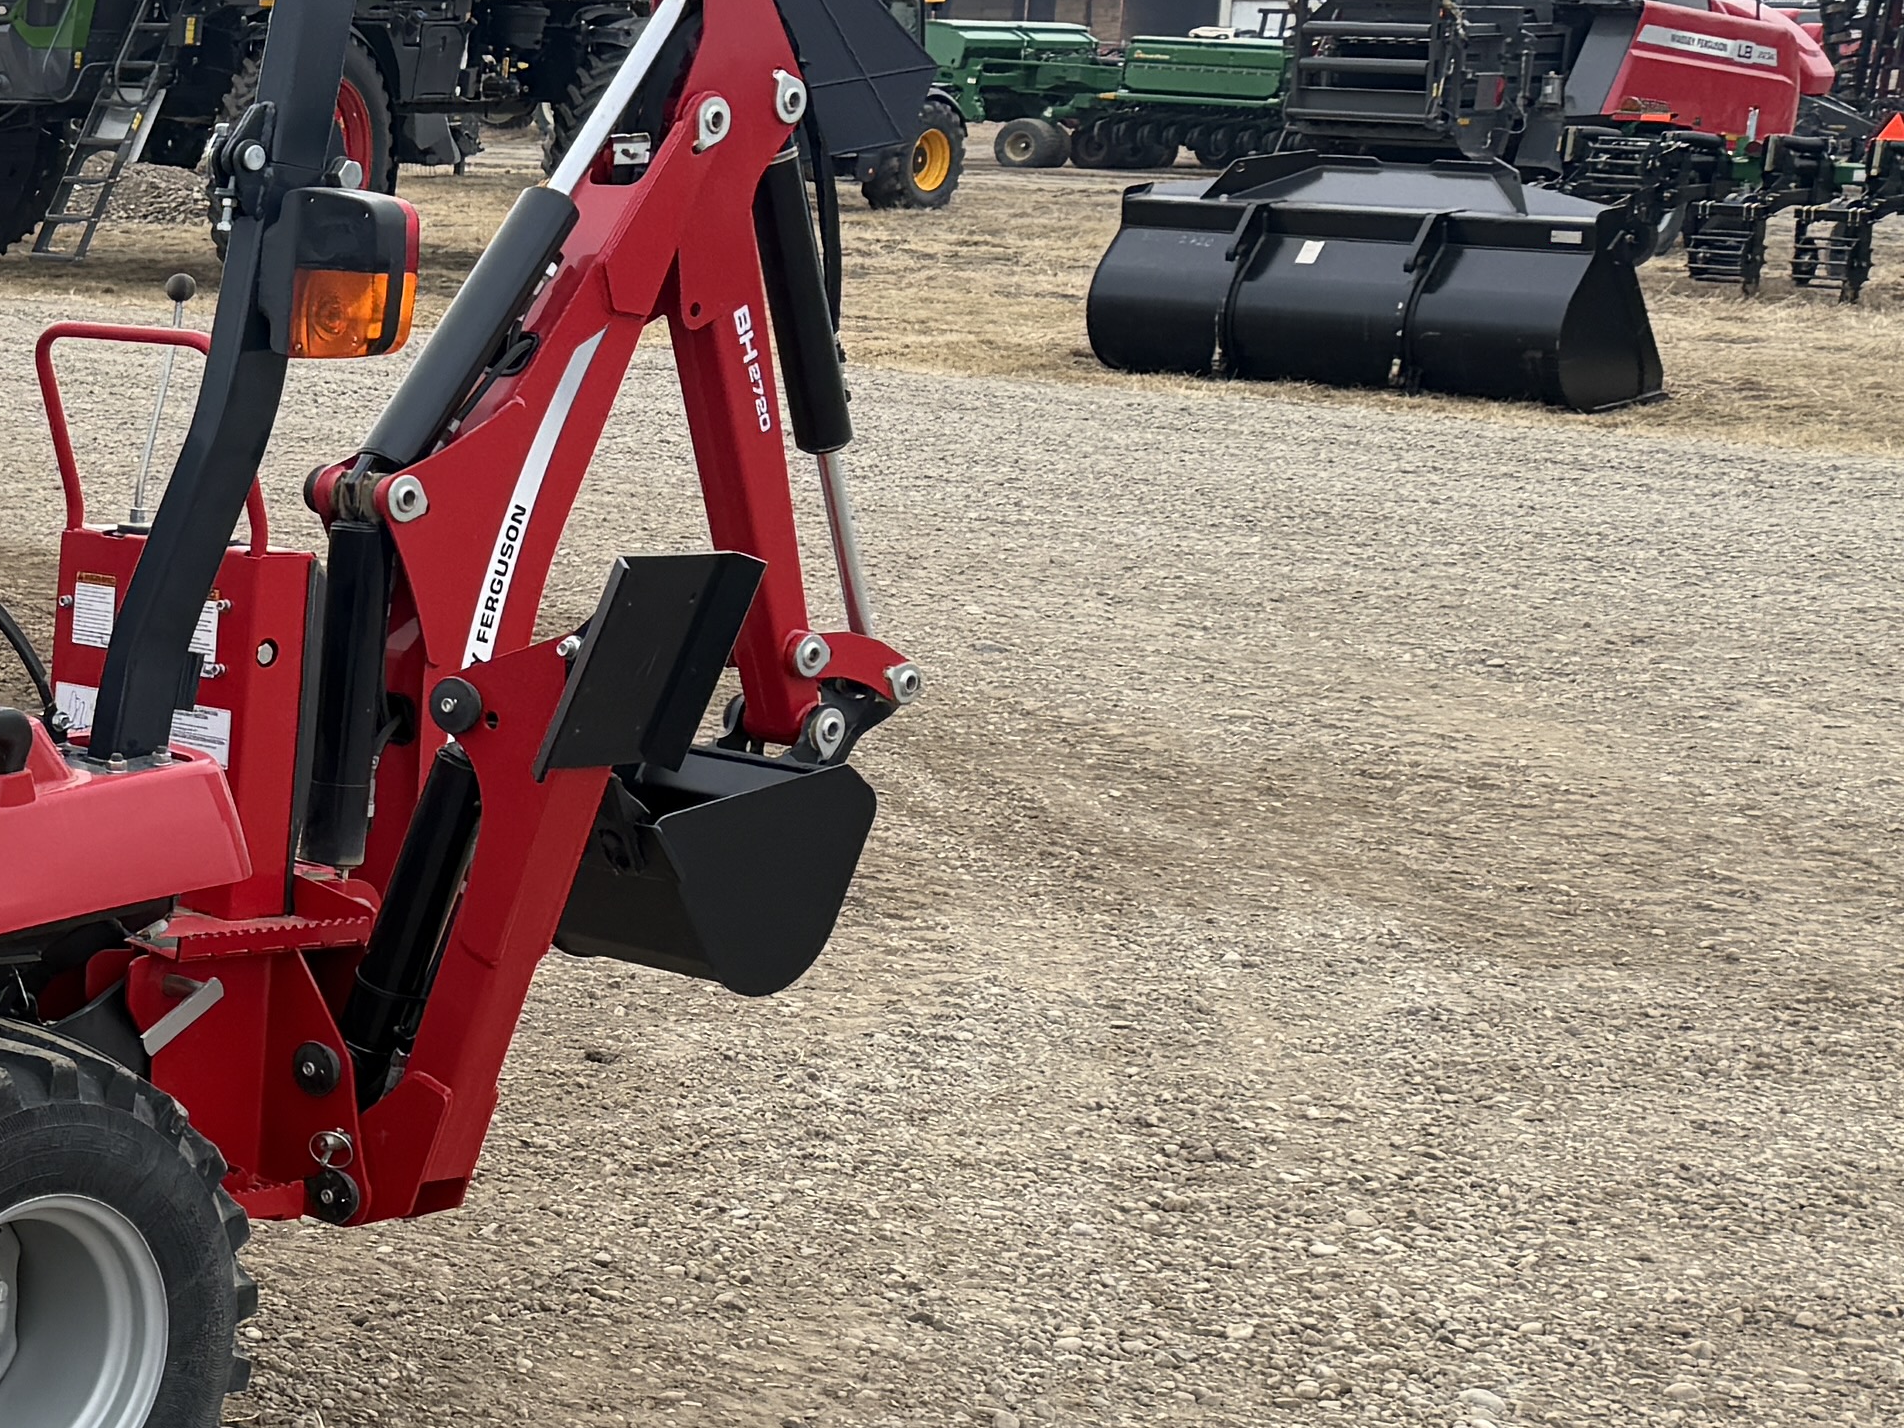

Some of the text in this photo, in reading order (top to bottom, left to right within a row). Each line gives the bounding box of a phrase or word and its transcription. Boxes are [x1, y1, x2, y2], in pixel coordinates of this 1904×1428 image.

[1670, 33, 1696, 47] MASSEY
[1697, 37, 1728, 52] FERGUSON
[1737, 43, 1753, 59] LB
[476, 504, 527, 644] FERGUSON
